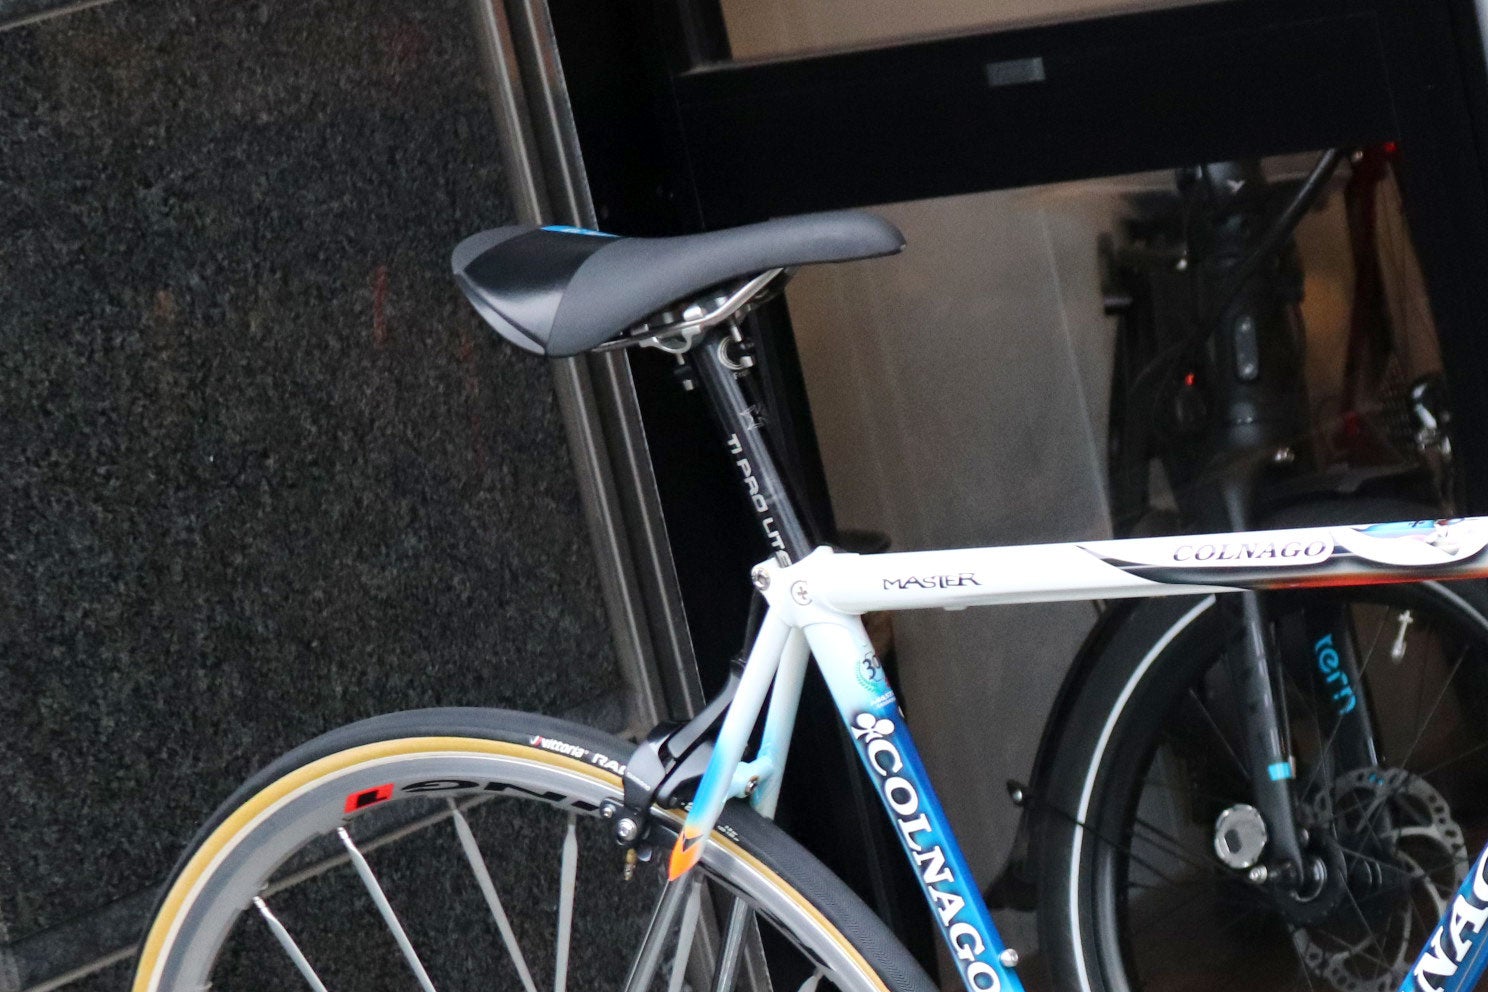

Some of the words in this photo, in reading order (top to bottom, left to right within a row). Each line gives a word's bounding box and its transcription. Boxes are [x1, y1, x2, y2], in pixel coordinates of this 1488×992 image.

[727, 433, 743, 454] TI
[737, 458, 769, 512] PRO
[762, 517, 793, 568] LITE
[1172, 539, 1327, 564] COLNAGO
[883, 572, 982, 592] MASTER
